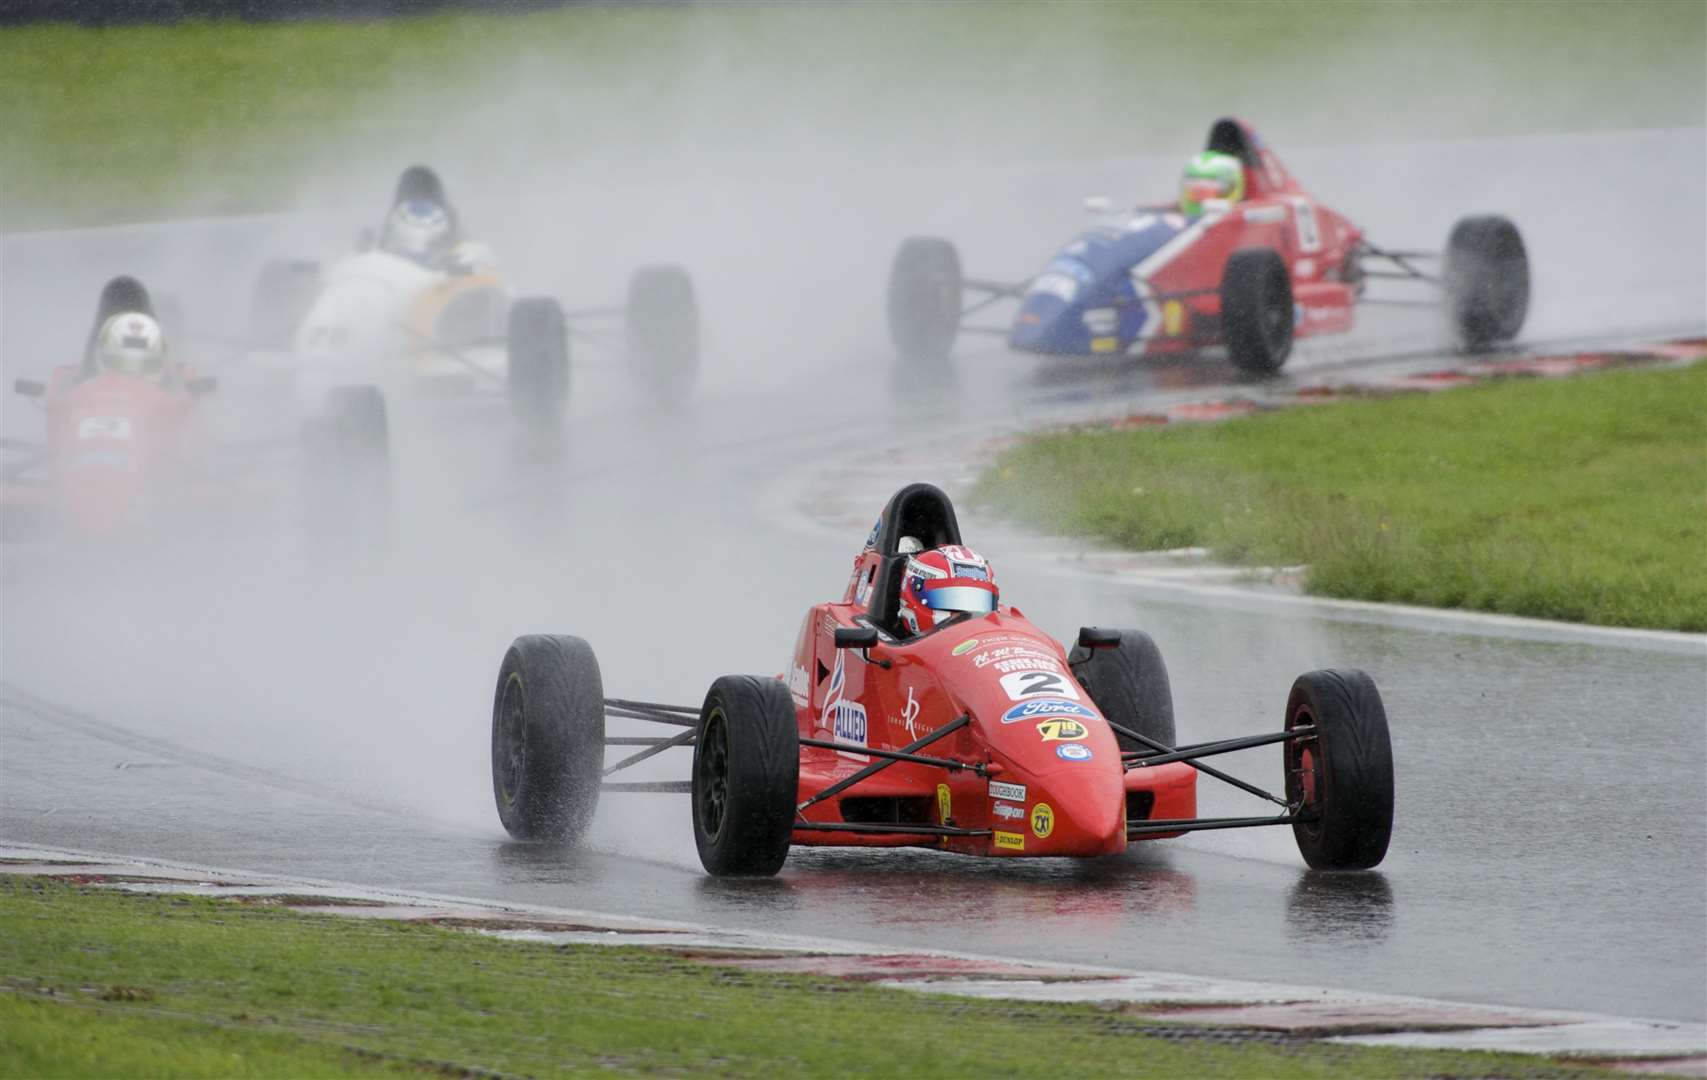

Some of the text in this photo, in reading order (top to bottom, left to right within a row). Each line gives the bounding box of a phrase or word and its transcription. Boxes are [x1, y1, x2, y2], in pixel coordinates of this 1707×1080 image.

[1020, 672, 1064, 696] 2
[1022, 702, 1080, 715] Ford
[835, 705, 866, 743] ALLIED
[989, 783, 1025, 800] TOUGHBOOK
[1034, 815, 1050, 832] ZX1
[999, 835, 1023, 846] DUNLOP
